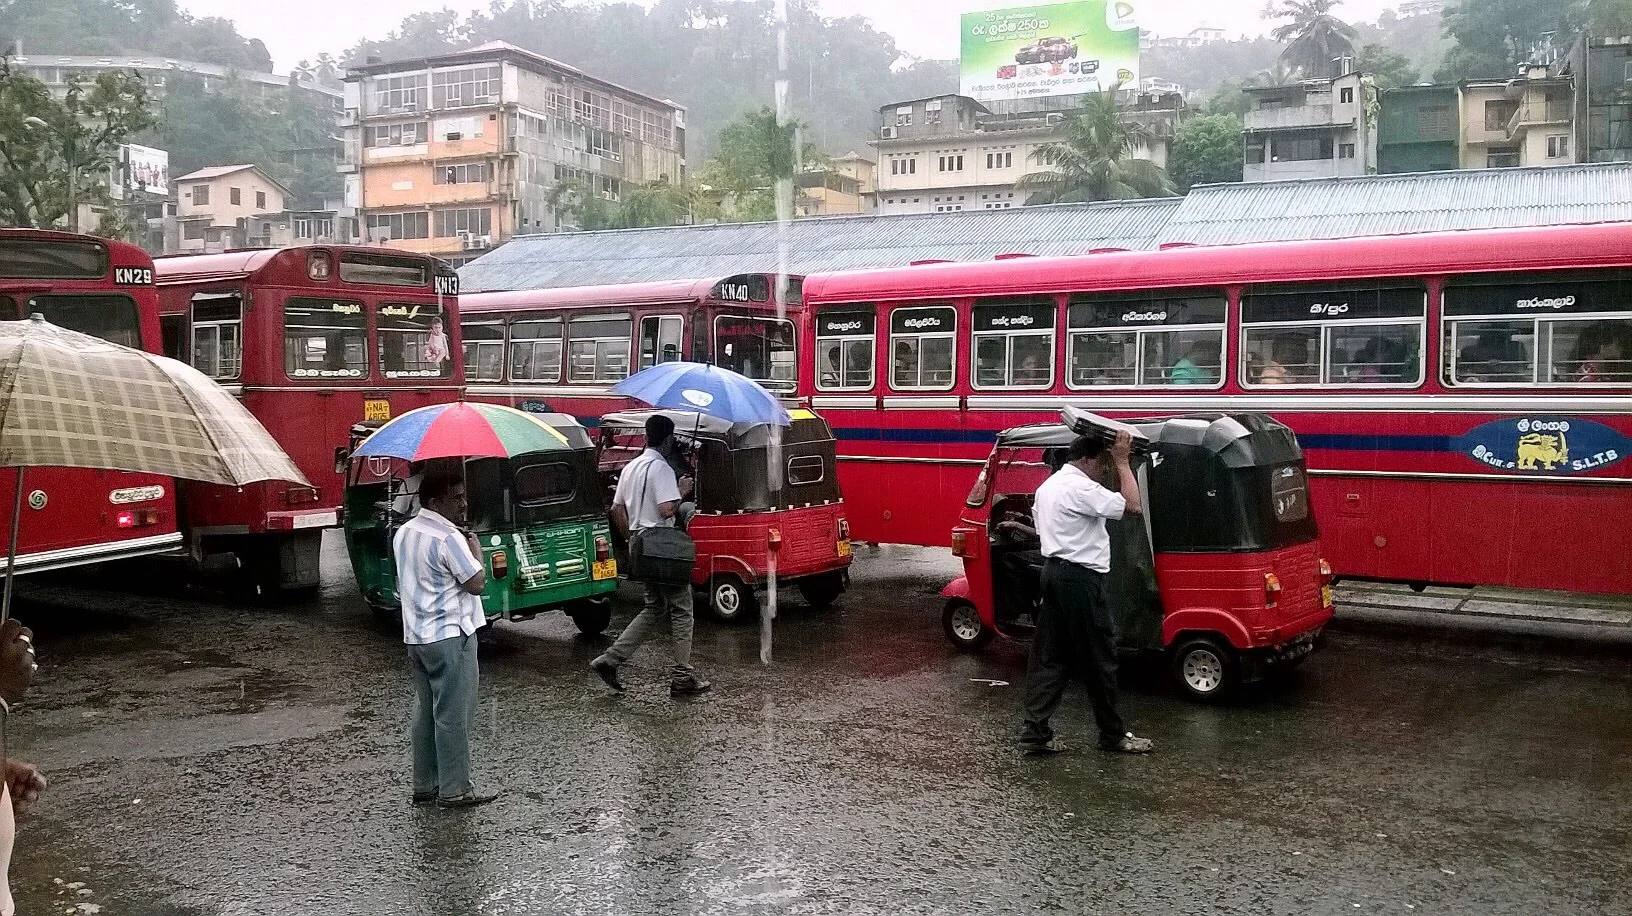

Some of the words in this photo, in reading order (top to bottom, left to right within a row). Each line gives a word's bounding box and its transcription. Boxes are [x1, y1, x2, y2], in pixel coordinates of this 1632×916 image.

[985, 13, 996, 22] 25
[115, 268, 152, 284] KN29
[434, 275, 458, 294] KN13
[721, 283, 748, 301] KN40
[827, 320, 862, 331] මහනුවර
[1530, 419, 1570, 432] ලංගම
[1572, 449, 1618, 471] S.L.T.B
